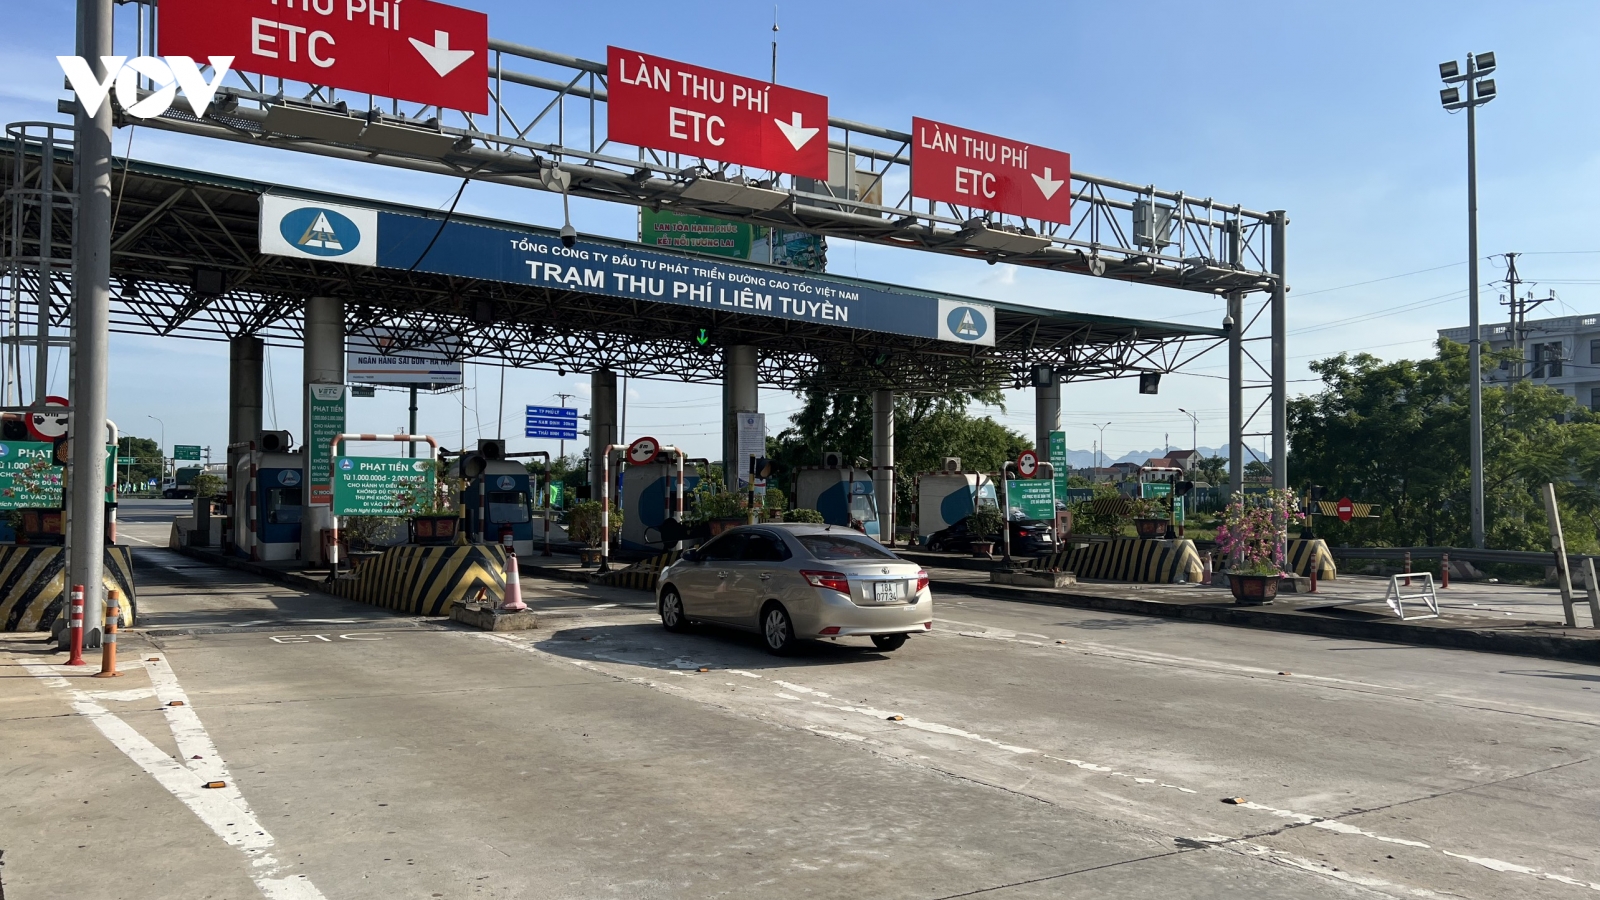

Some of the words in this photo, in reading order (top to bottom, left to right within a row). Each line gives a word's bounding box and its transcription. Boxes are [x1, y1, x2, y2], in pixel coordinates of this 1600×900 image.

[251, 16, 336, 68] ETC
[619, 55, 671, 93] LÀN
[677, 71, 725, 104] THU
[732, 84, 771, 114] PHÍ
[669, 106, 726, 147] ETC
[921, 123, 957, 155] LÀN
[962, 136, 996, 162] THU
[1001, 145, 1029, 170] PHÍ
[955, 165, 996, 199] ETC
[654, 222, 671, 232] LAN
[720, 239, 735, 248] LAI
[510, 237, 548, 254] TỔNG
[592, 252, 608, 263] TY
[611, 253, 637, 267] ĐẦU
[640, 259, 657, 270] TƯ
[659, 262, 690, 276] PHÁT
[692, 266, 725, 281] TRIỂN
[728, 272, 766, 287] ĐƯỜNG
[768, 279, 790, 290] CAO
[792, 281, 813, 294] TỐC
[814, 286, 835, 298] VIỆT
[838, 289, 859, 301] NAM
[525, 259, 605, 289] TRẠM
[612, 272, 665, 296] THU
[673, 281, 713, 303] PHÍ
[719, 287, 772, 311] LIÊM
[313, 405, 329, 414] PHẠT
[18, 448, 52, 460] PHẠT
[360, 462, 386, 472] PHẠT
[881, 583, 892, 592] 18A
[269, 633, 386, 644] ETC
